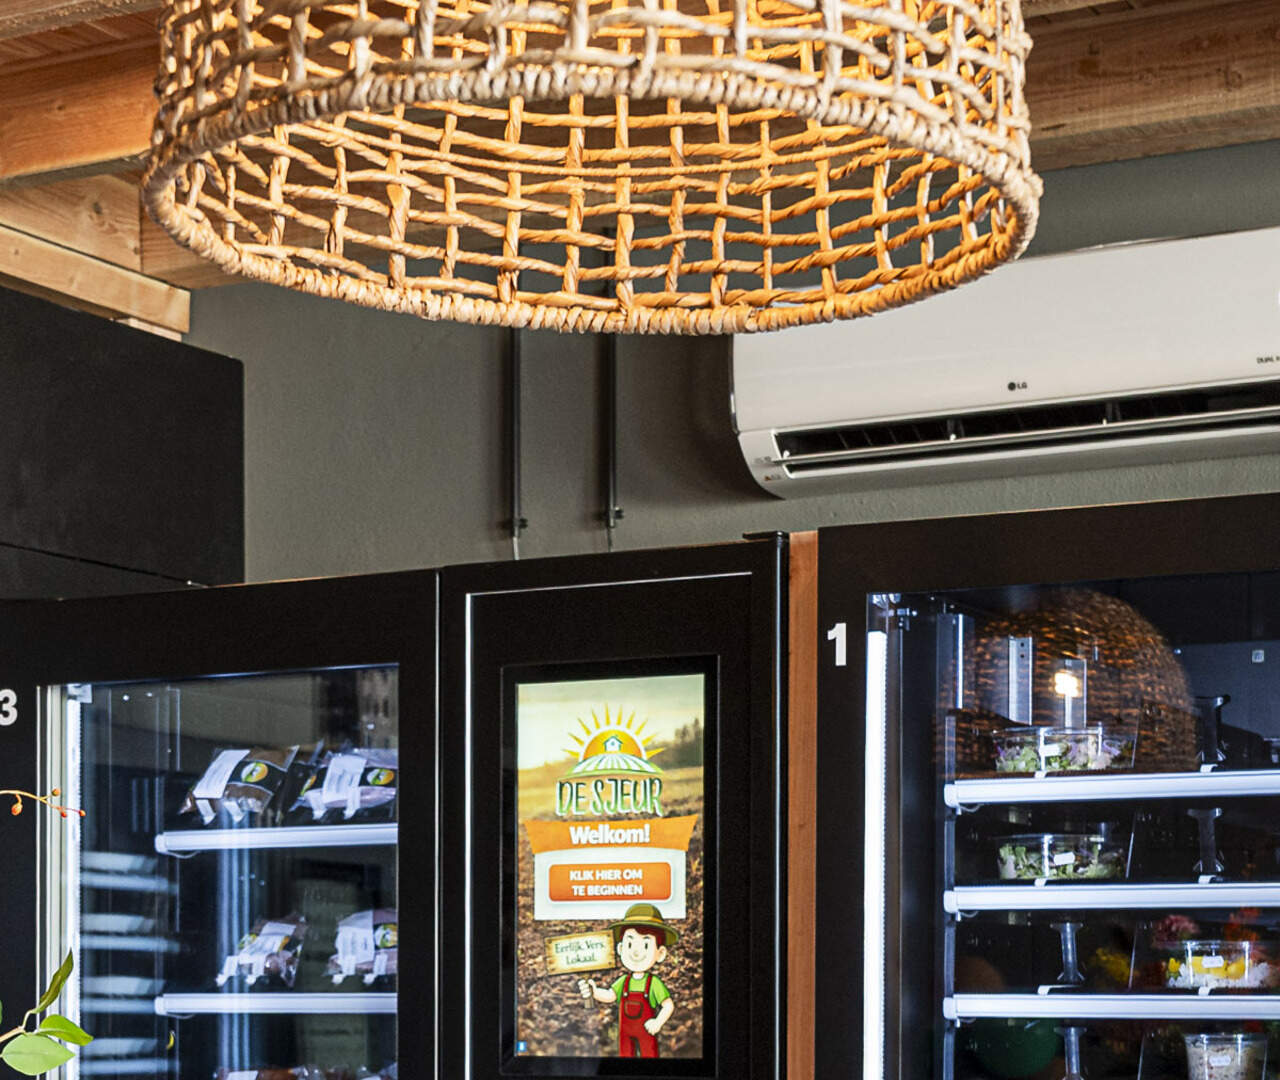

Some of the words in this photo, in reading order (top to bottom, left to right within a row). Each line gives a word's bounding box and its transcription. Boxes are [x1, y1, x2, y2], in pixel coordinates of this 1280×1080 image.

[826, 623, 848, 667] 1
[556, 780, 588, 816] DE
[590, 777, 664, 817] SJEUR
[569, 823, 651, 847] Welkom!
[569, 869, 595, 881] KLIK
[597, 869, 621, 881] HIER
[622, 868, 643, 880] OM
[571, 885, 585, 896] TE
[586, 884, 643, 896] BEGINNEN
